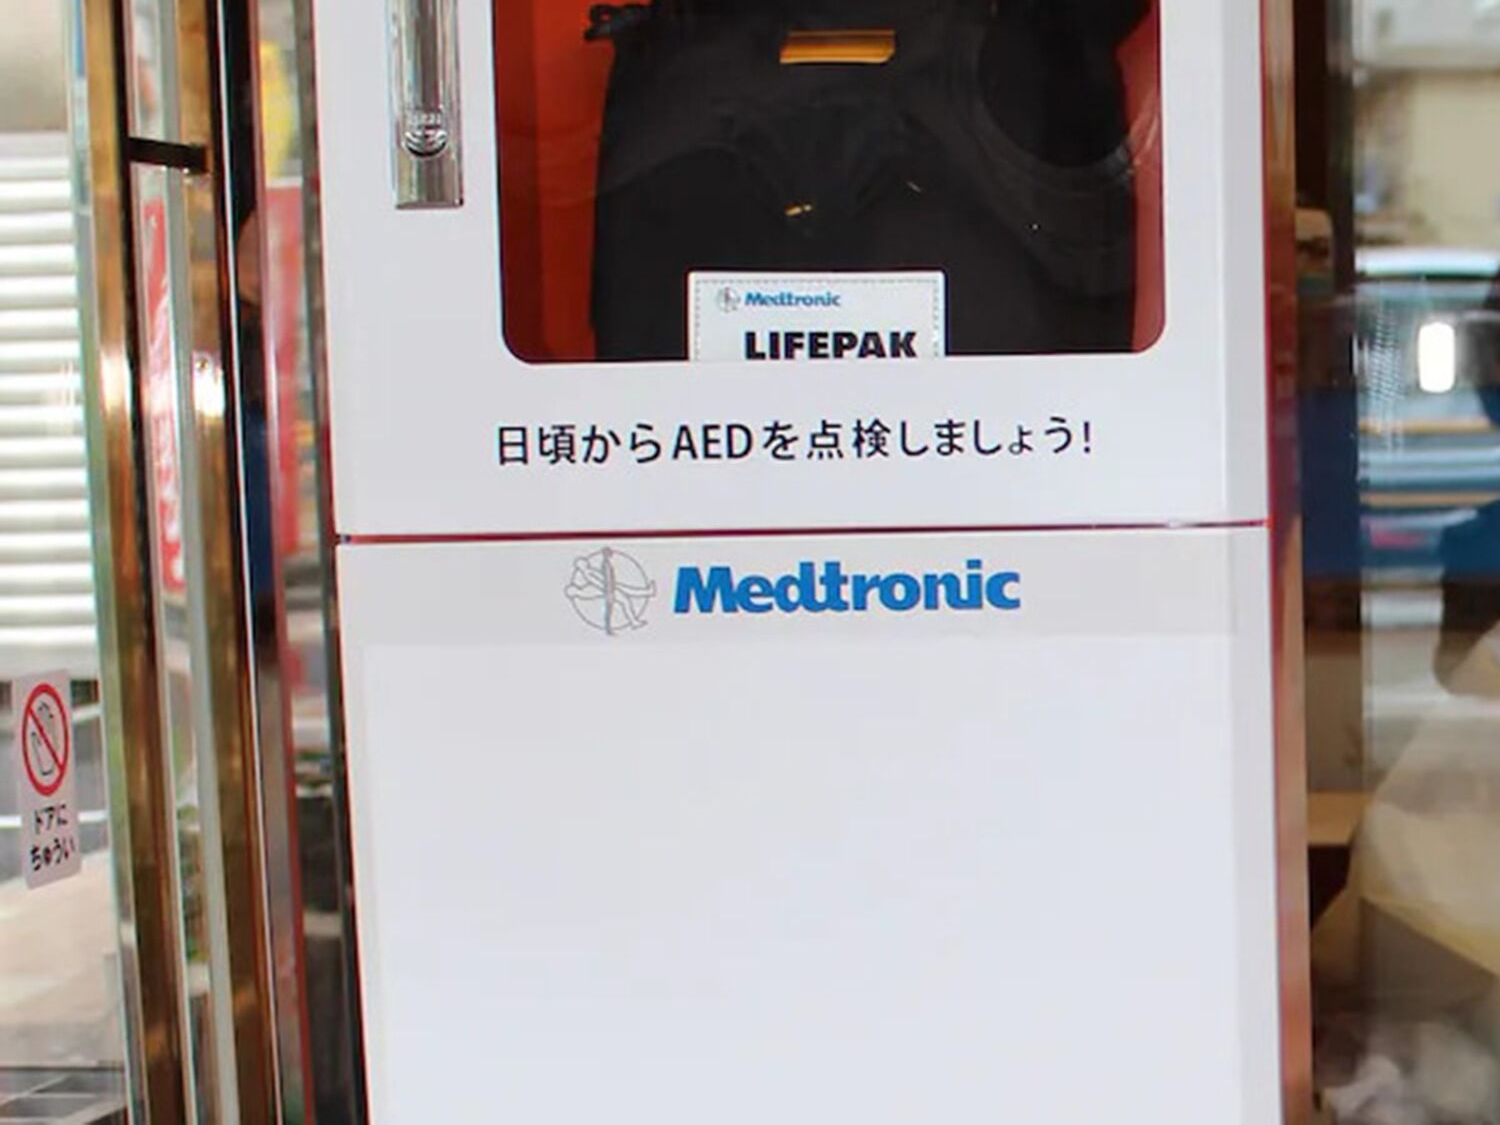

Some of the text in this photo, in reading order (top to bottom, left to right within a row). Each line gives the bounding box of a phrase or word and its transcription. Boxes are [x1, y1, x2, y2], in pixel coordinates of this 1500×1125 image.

[744, 291, 842, 307] Medtronic
[745, 331, 917, 361] LIFEPAK
[672, 558, 1021, 614] Medtronic
[30, 837, 76, 871] ちゅうい
